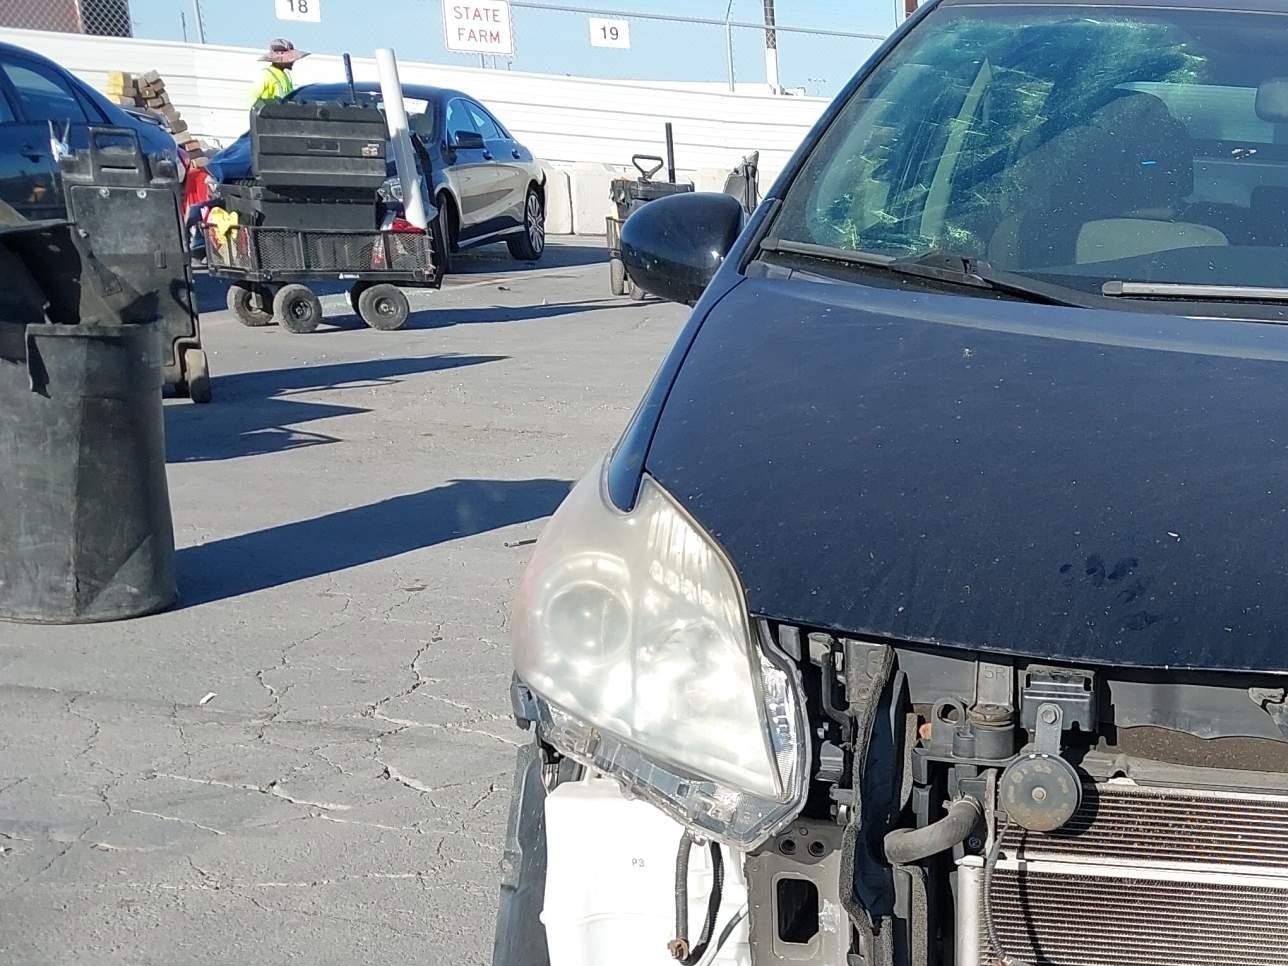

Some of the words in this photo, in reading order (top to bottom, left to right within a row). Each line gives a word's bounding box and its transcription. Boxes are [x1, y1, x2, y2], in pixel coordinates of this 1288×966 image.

[286, 0, 308, 13] 18
[453, 6, 501, 23] STATE
[457, 28, 500, 44] FARM
[600, 26, 619, 41] 19
